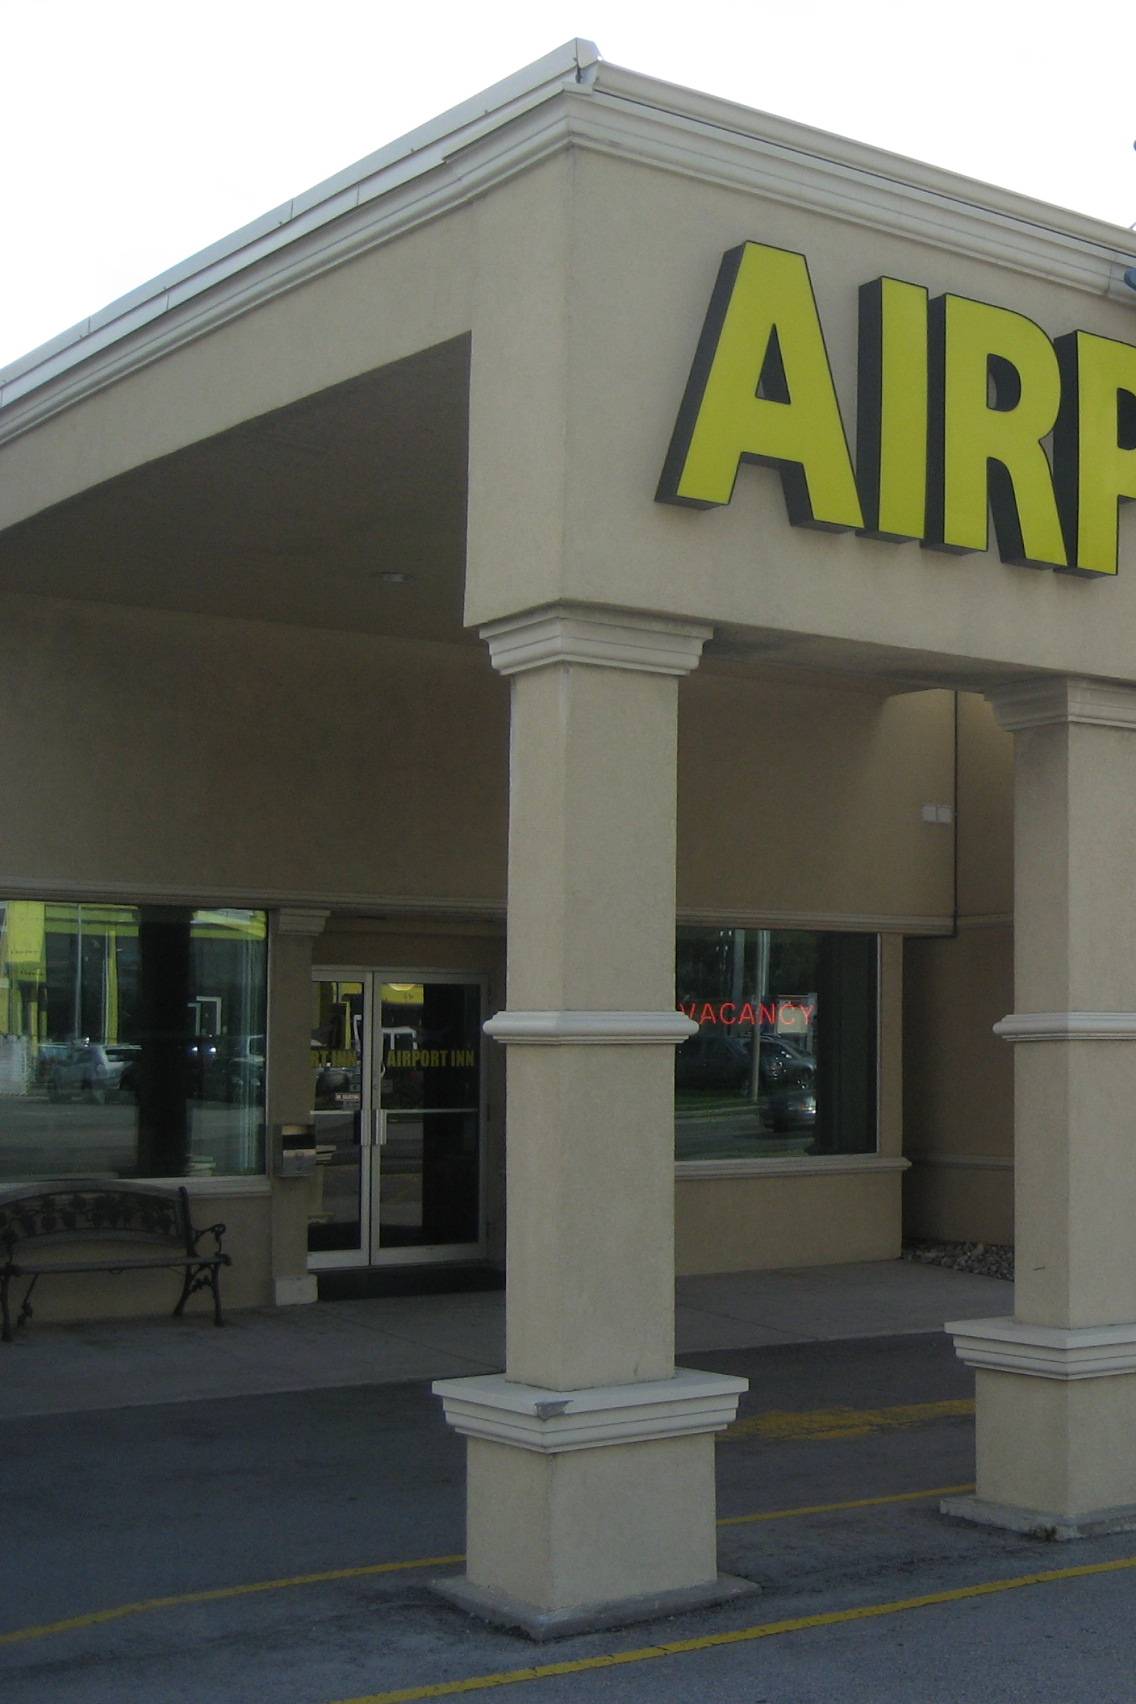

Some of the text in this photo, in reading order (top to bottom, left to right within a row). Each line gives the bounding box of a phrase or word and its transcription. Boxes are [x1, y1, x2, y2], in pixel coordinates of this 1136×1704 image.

[680, 1001, 817, 1025] VACANCY
[387, 1049, 475, 1067] AIRPORT INN
